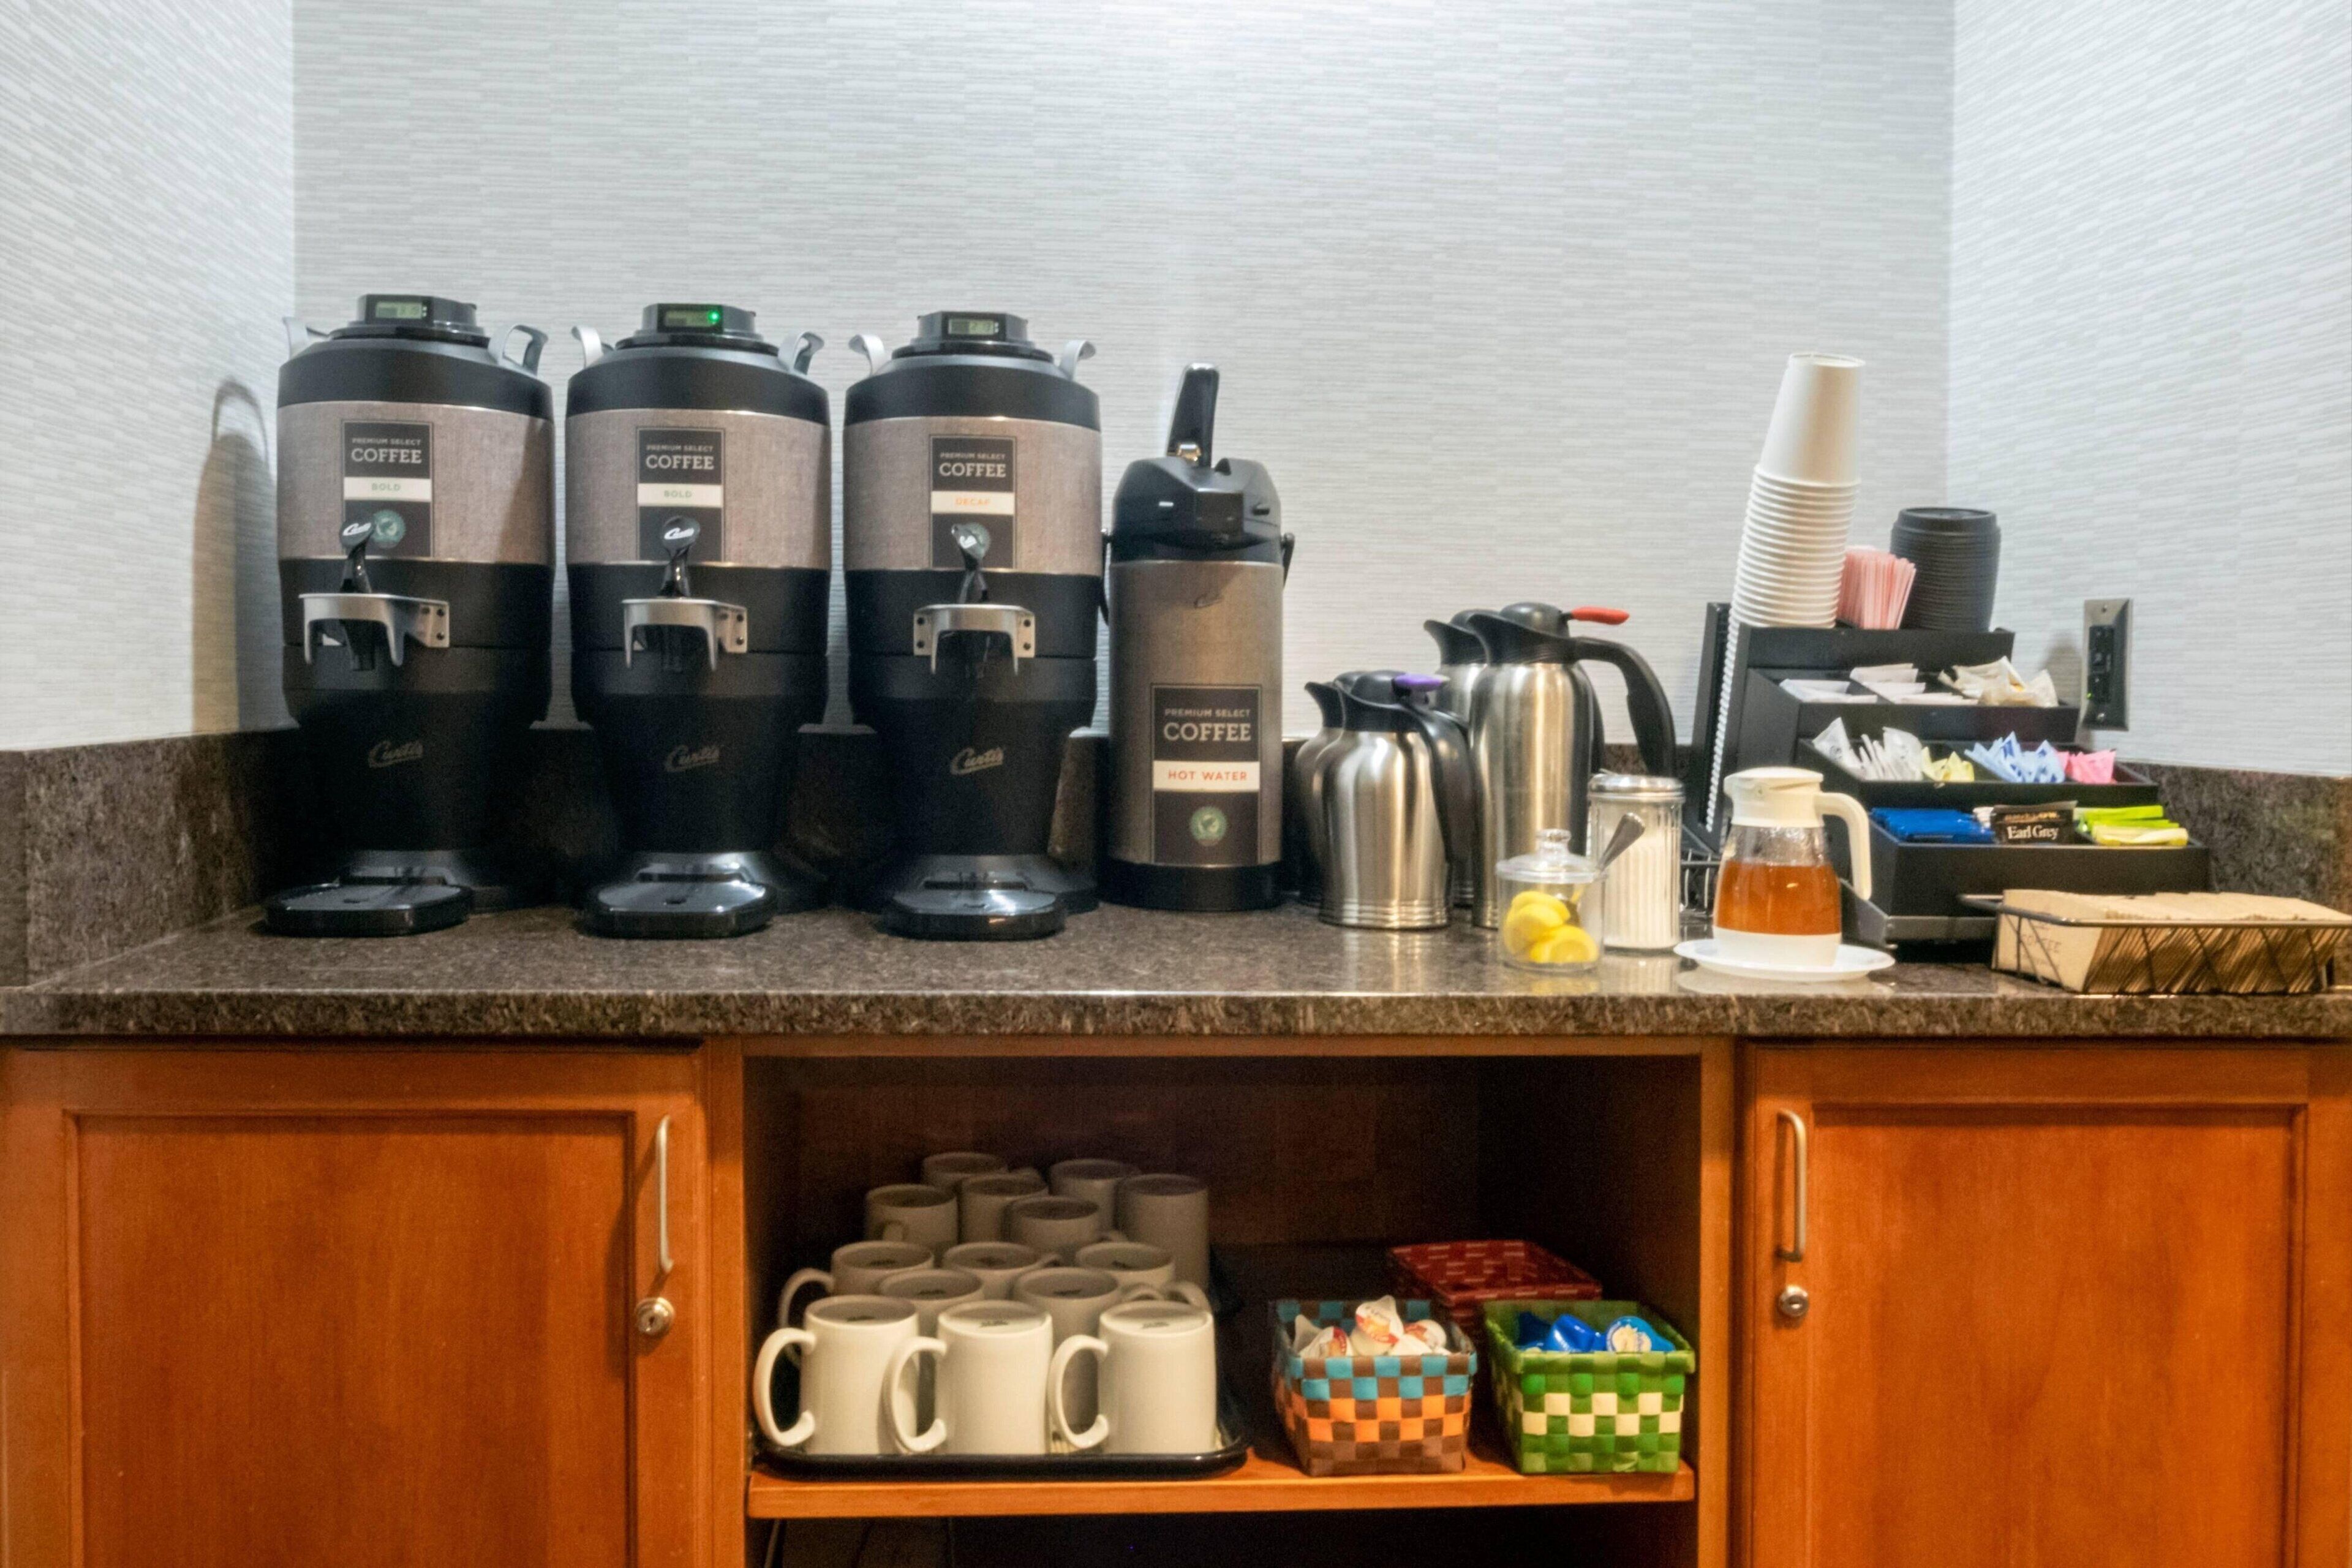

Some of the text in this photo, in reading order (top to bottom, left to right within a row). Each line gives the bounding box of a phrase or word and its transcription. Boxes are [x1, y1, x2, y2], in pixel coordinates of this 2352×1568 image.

[351, 448, 422, 464] COFFEE
[646, 454, 715, 470] COFFEE
[939, 462, 1006, 478] COFFEE
[956, 497, 990, 506] DECAF
[1165, 708, 1250, 717] PREMIUM SELECT
[1164, 722, 1252, 742] COFFEE
[1168, 770, 1248, 781] HOT WATER
[2007, 824, 2060, 840] Earl Grey
